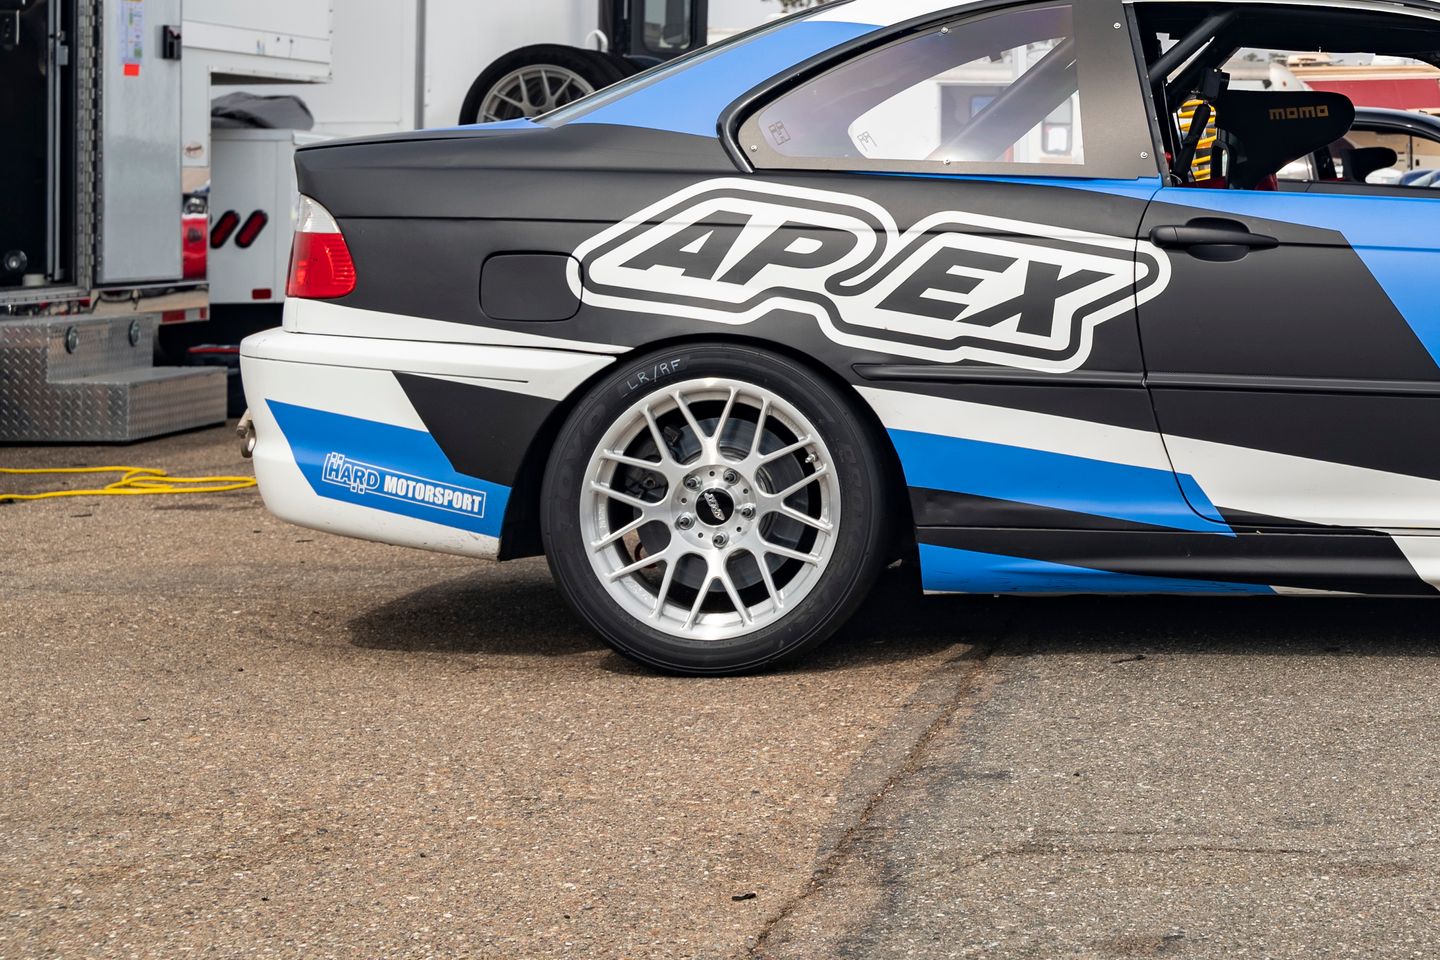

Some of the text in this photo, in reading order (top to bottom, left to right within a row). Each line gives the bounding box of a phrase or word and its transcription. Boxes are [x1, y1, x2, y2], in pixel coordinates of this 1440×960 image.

[612, 206, 1122, 342] APEX
[626, 358, 681, 390] LR/RF
[383, 474, 482, 513] MOTORSPORT
